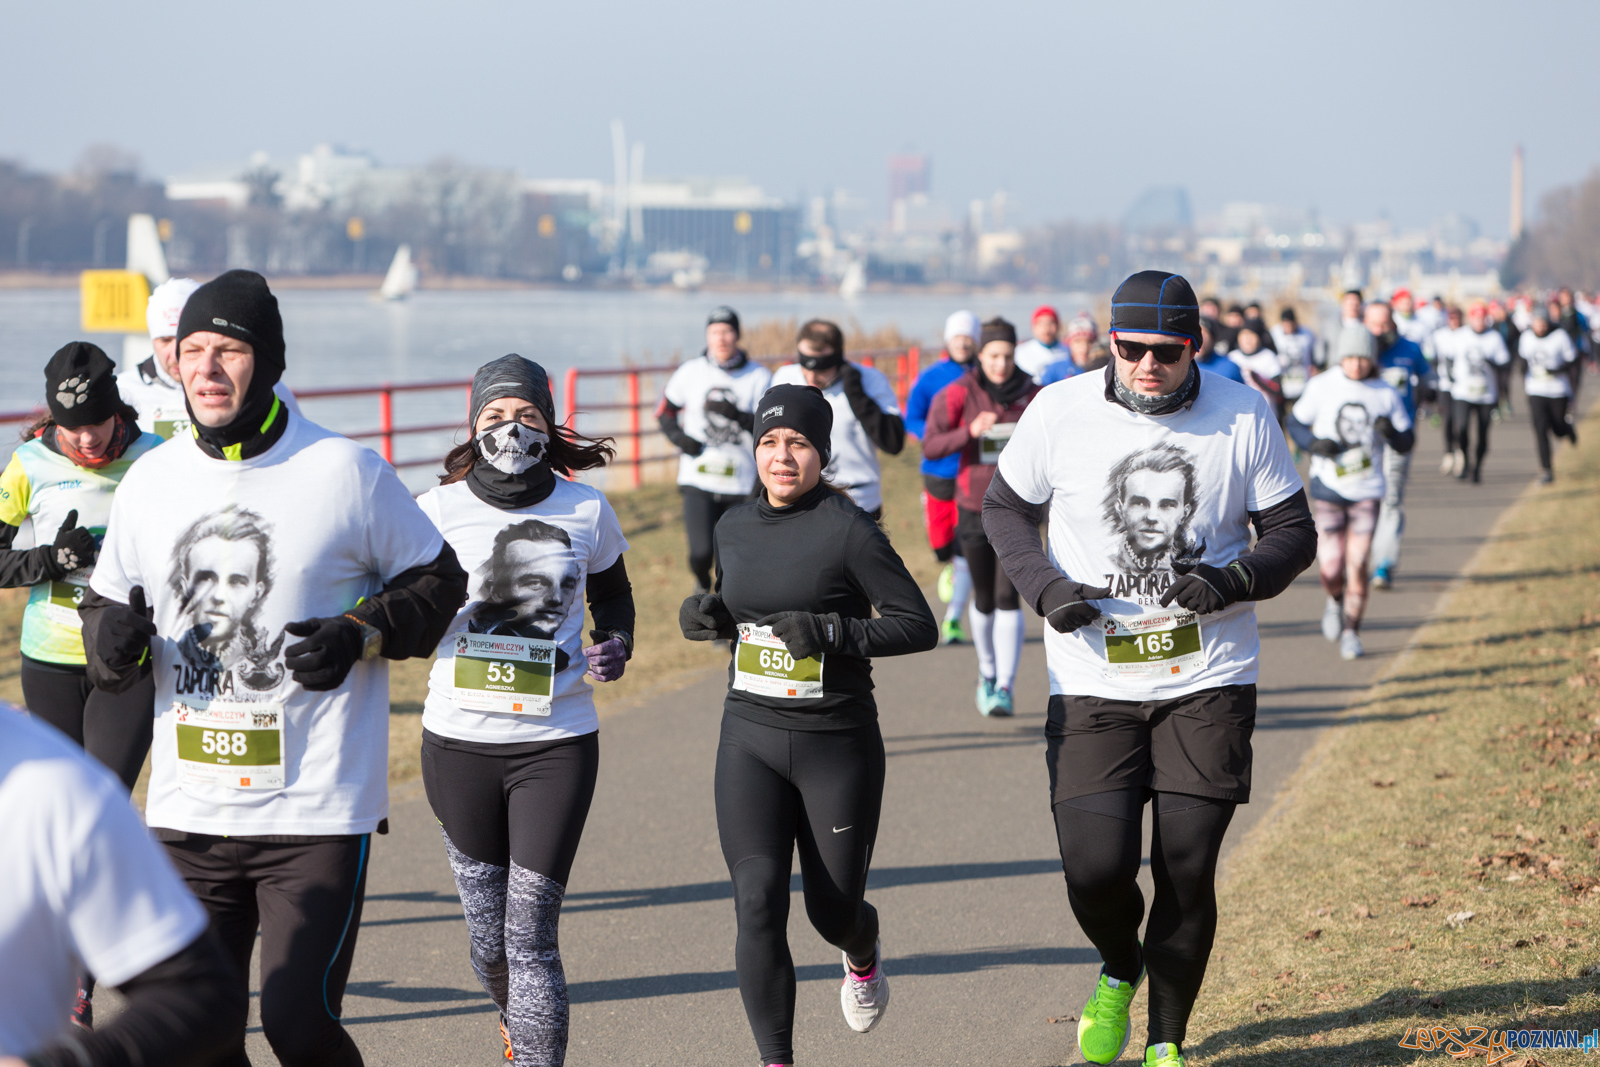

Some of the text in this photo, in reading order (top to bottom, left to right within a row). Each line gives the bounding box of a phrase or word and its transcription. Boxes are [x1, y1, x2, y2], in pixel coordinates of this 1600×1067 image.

[1103, 572, 1171, 598] ZAPORA
[469, 640, 524, 652] TROPEMWILCZYM
[1133, 632, 1174, 655] 165
[486, 661, 515, 683] 53
[759, 649, 795, 672] 650
[172, 664, 234, 696] ZAPORA
[764, 670, 788, 678] WERONIKA
[201, 730, 248, 756] 588
